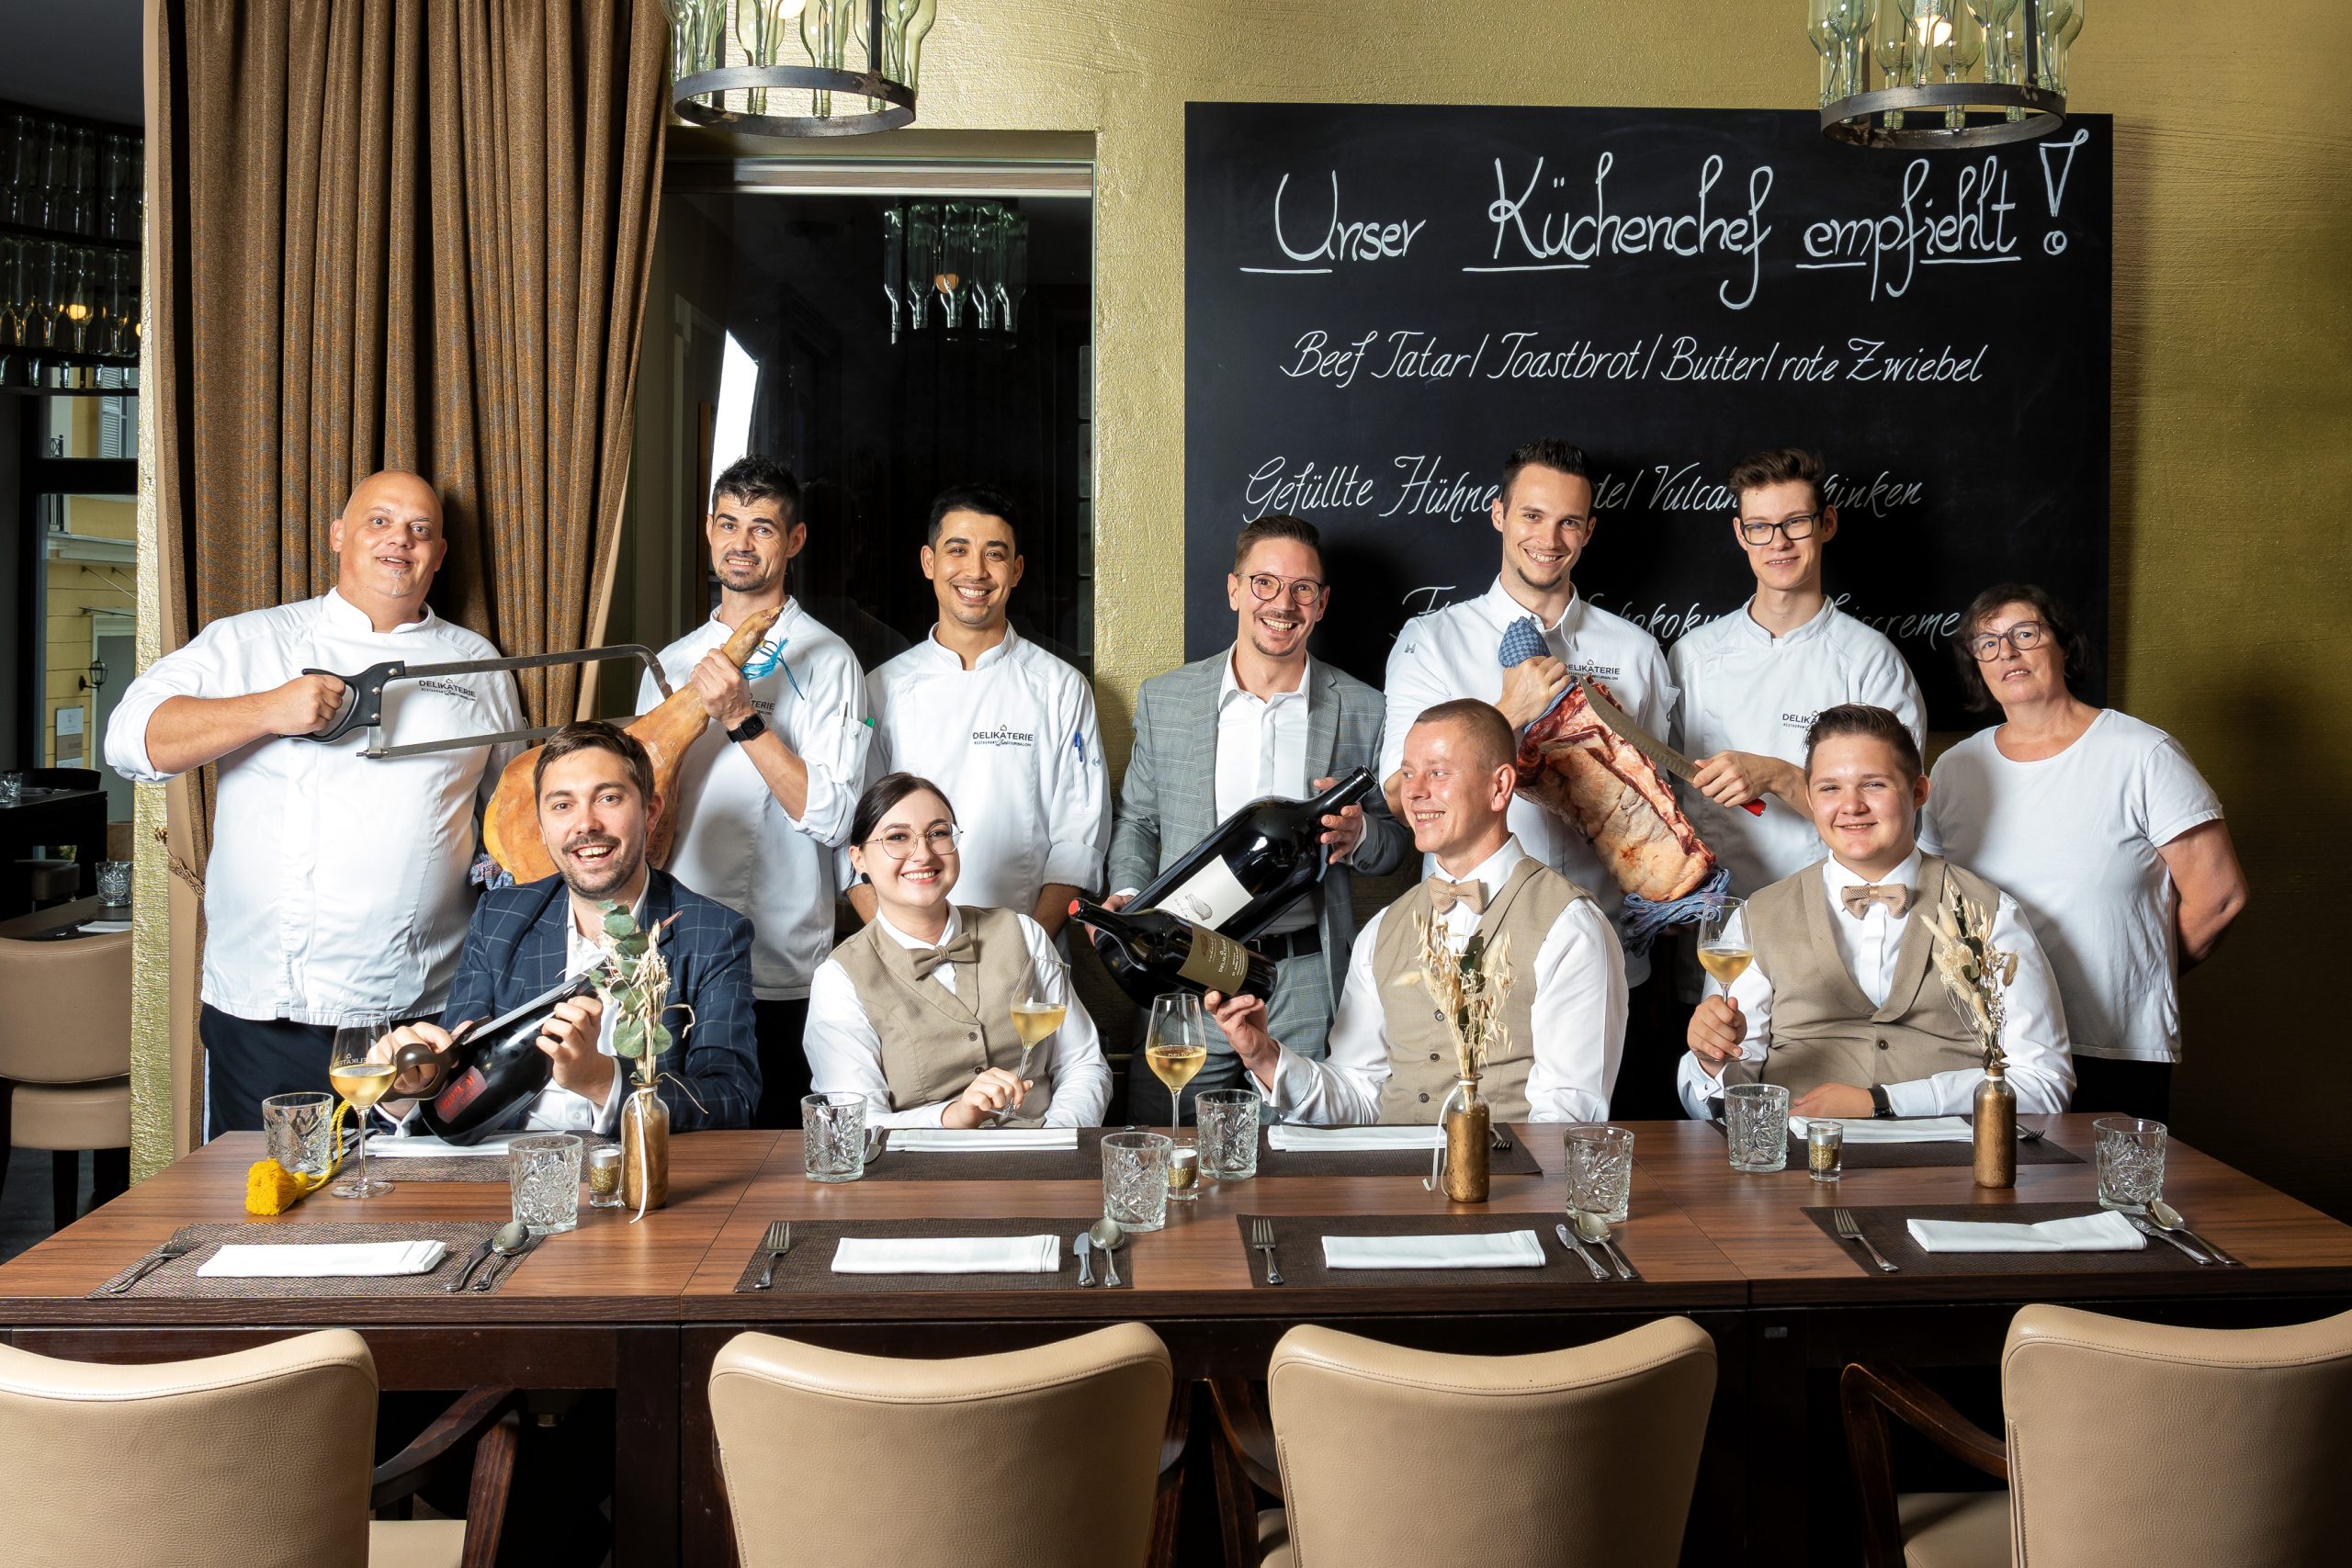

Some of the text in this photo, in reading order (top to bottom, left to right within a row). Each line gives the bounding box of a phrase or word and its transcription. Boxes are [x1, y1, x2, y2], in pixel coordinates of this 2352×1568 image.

[1275, 170, 1426, 262] Unser
[1488, 152, 1774, 310] Küchenchef
[1280, 330, 1378, 389] Beef
[1778, 345, 1839, 382] rote
[1846, 337, 1989, 382] Zwiebel
[1242, 456, 1374, 524] Gefüllte
[1379, 455, 1503, 524] Hühne
[1649, 462, 1739, 511] Vulcan
[1823, 470, 1923, 518] hinken
[1566, 663, 1621, 675] ELIKATERIE
[419, 680, 477, 698] DELIKATERIE
[752, 700, 776, 710] TERIE
[973, 731, 1034, 741] DELIKATERIE
